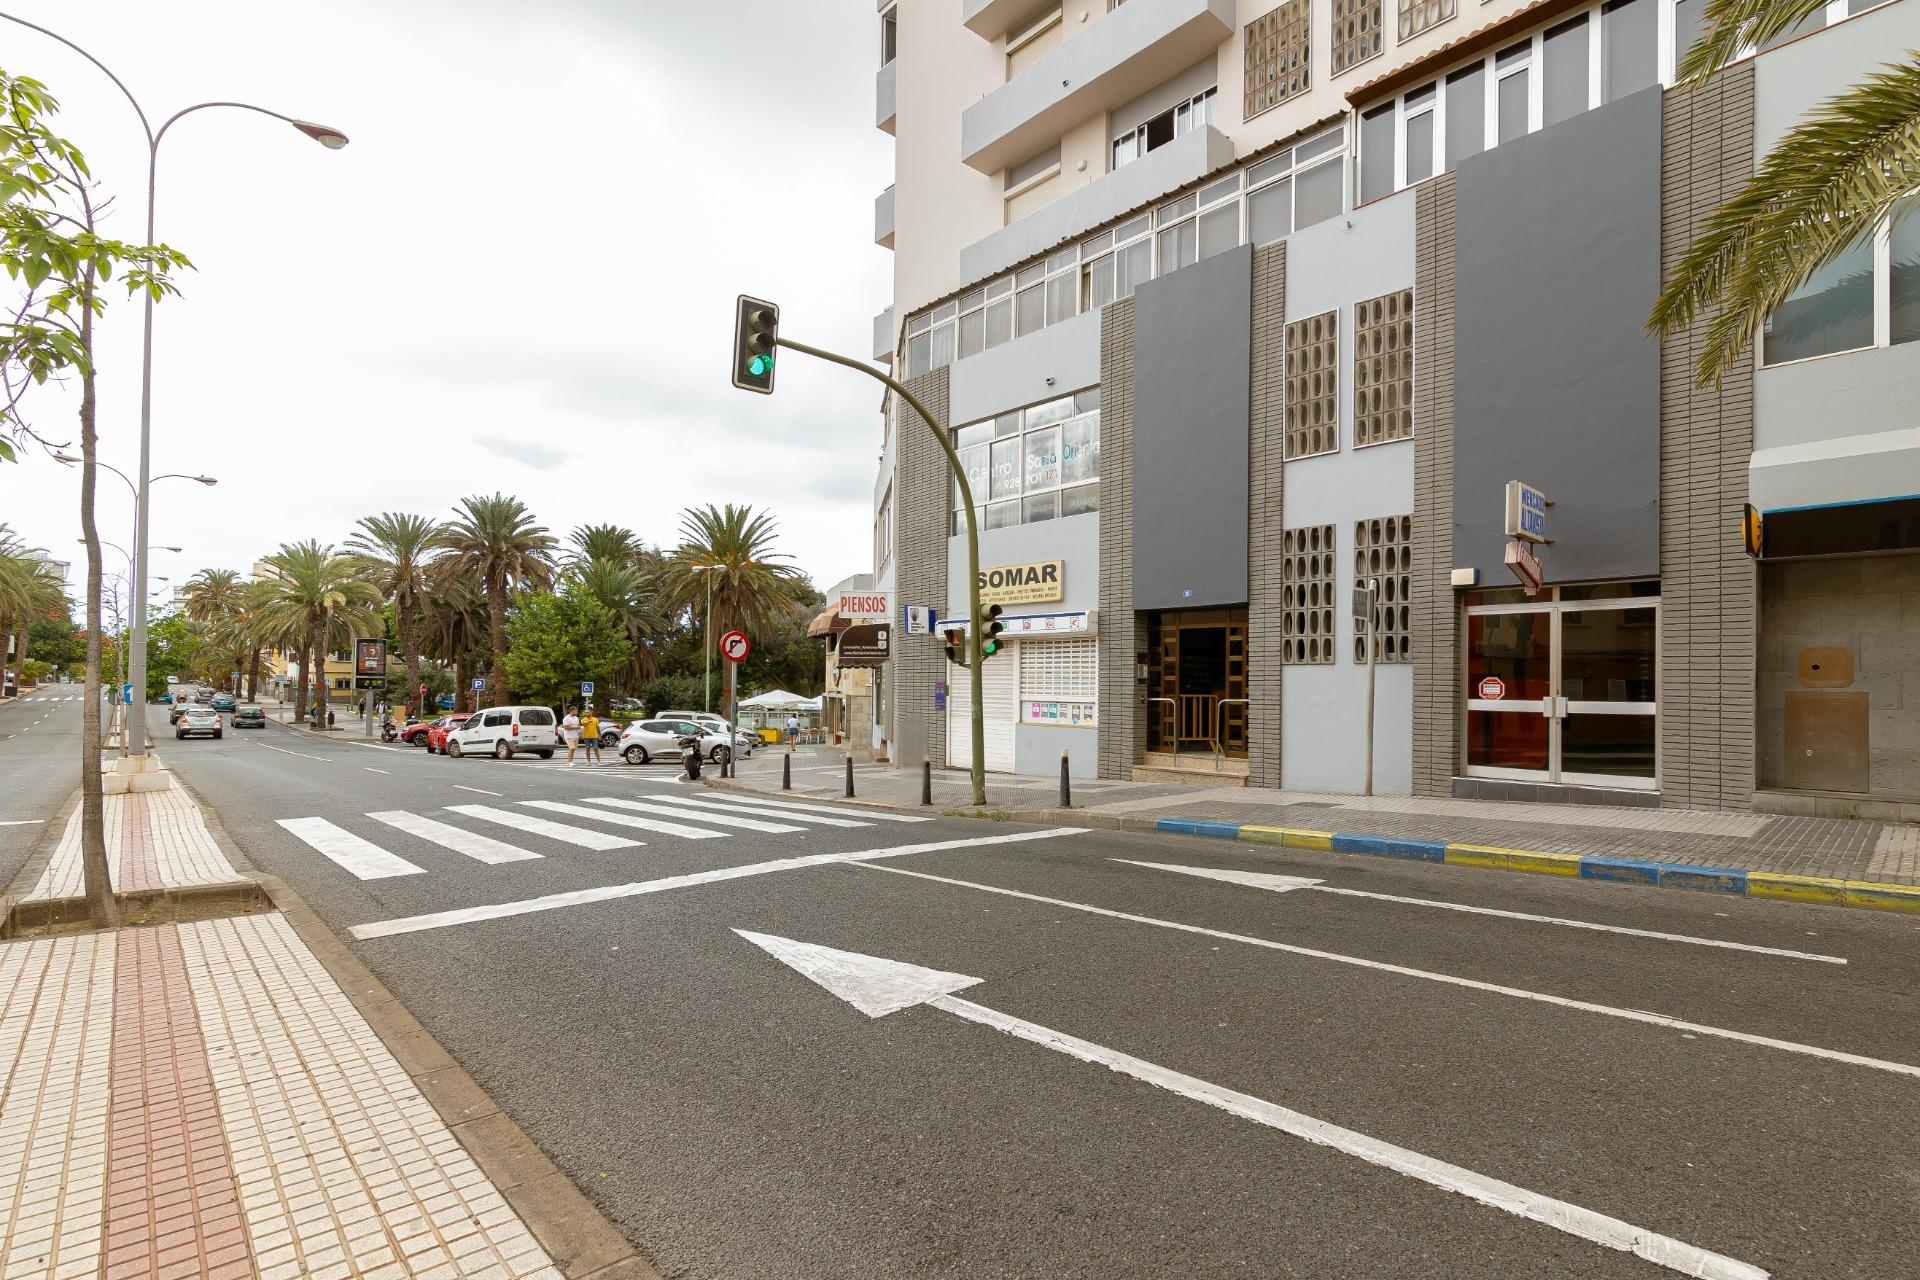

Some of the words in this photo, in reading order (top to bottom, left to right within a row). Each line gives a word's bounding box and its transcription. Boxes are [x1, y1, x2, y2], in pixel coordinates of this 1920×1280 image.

[969, 462, 1012, 481] Centro
[1063, 440, 1100, 460] Orienta
[1521, 487, 1545, 513] MERCADO
[977, 563, 1058, 589] SOMAR
[841, 596, 886, 613] PIENSOS
[475, 680, 482, 688] P
